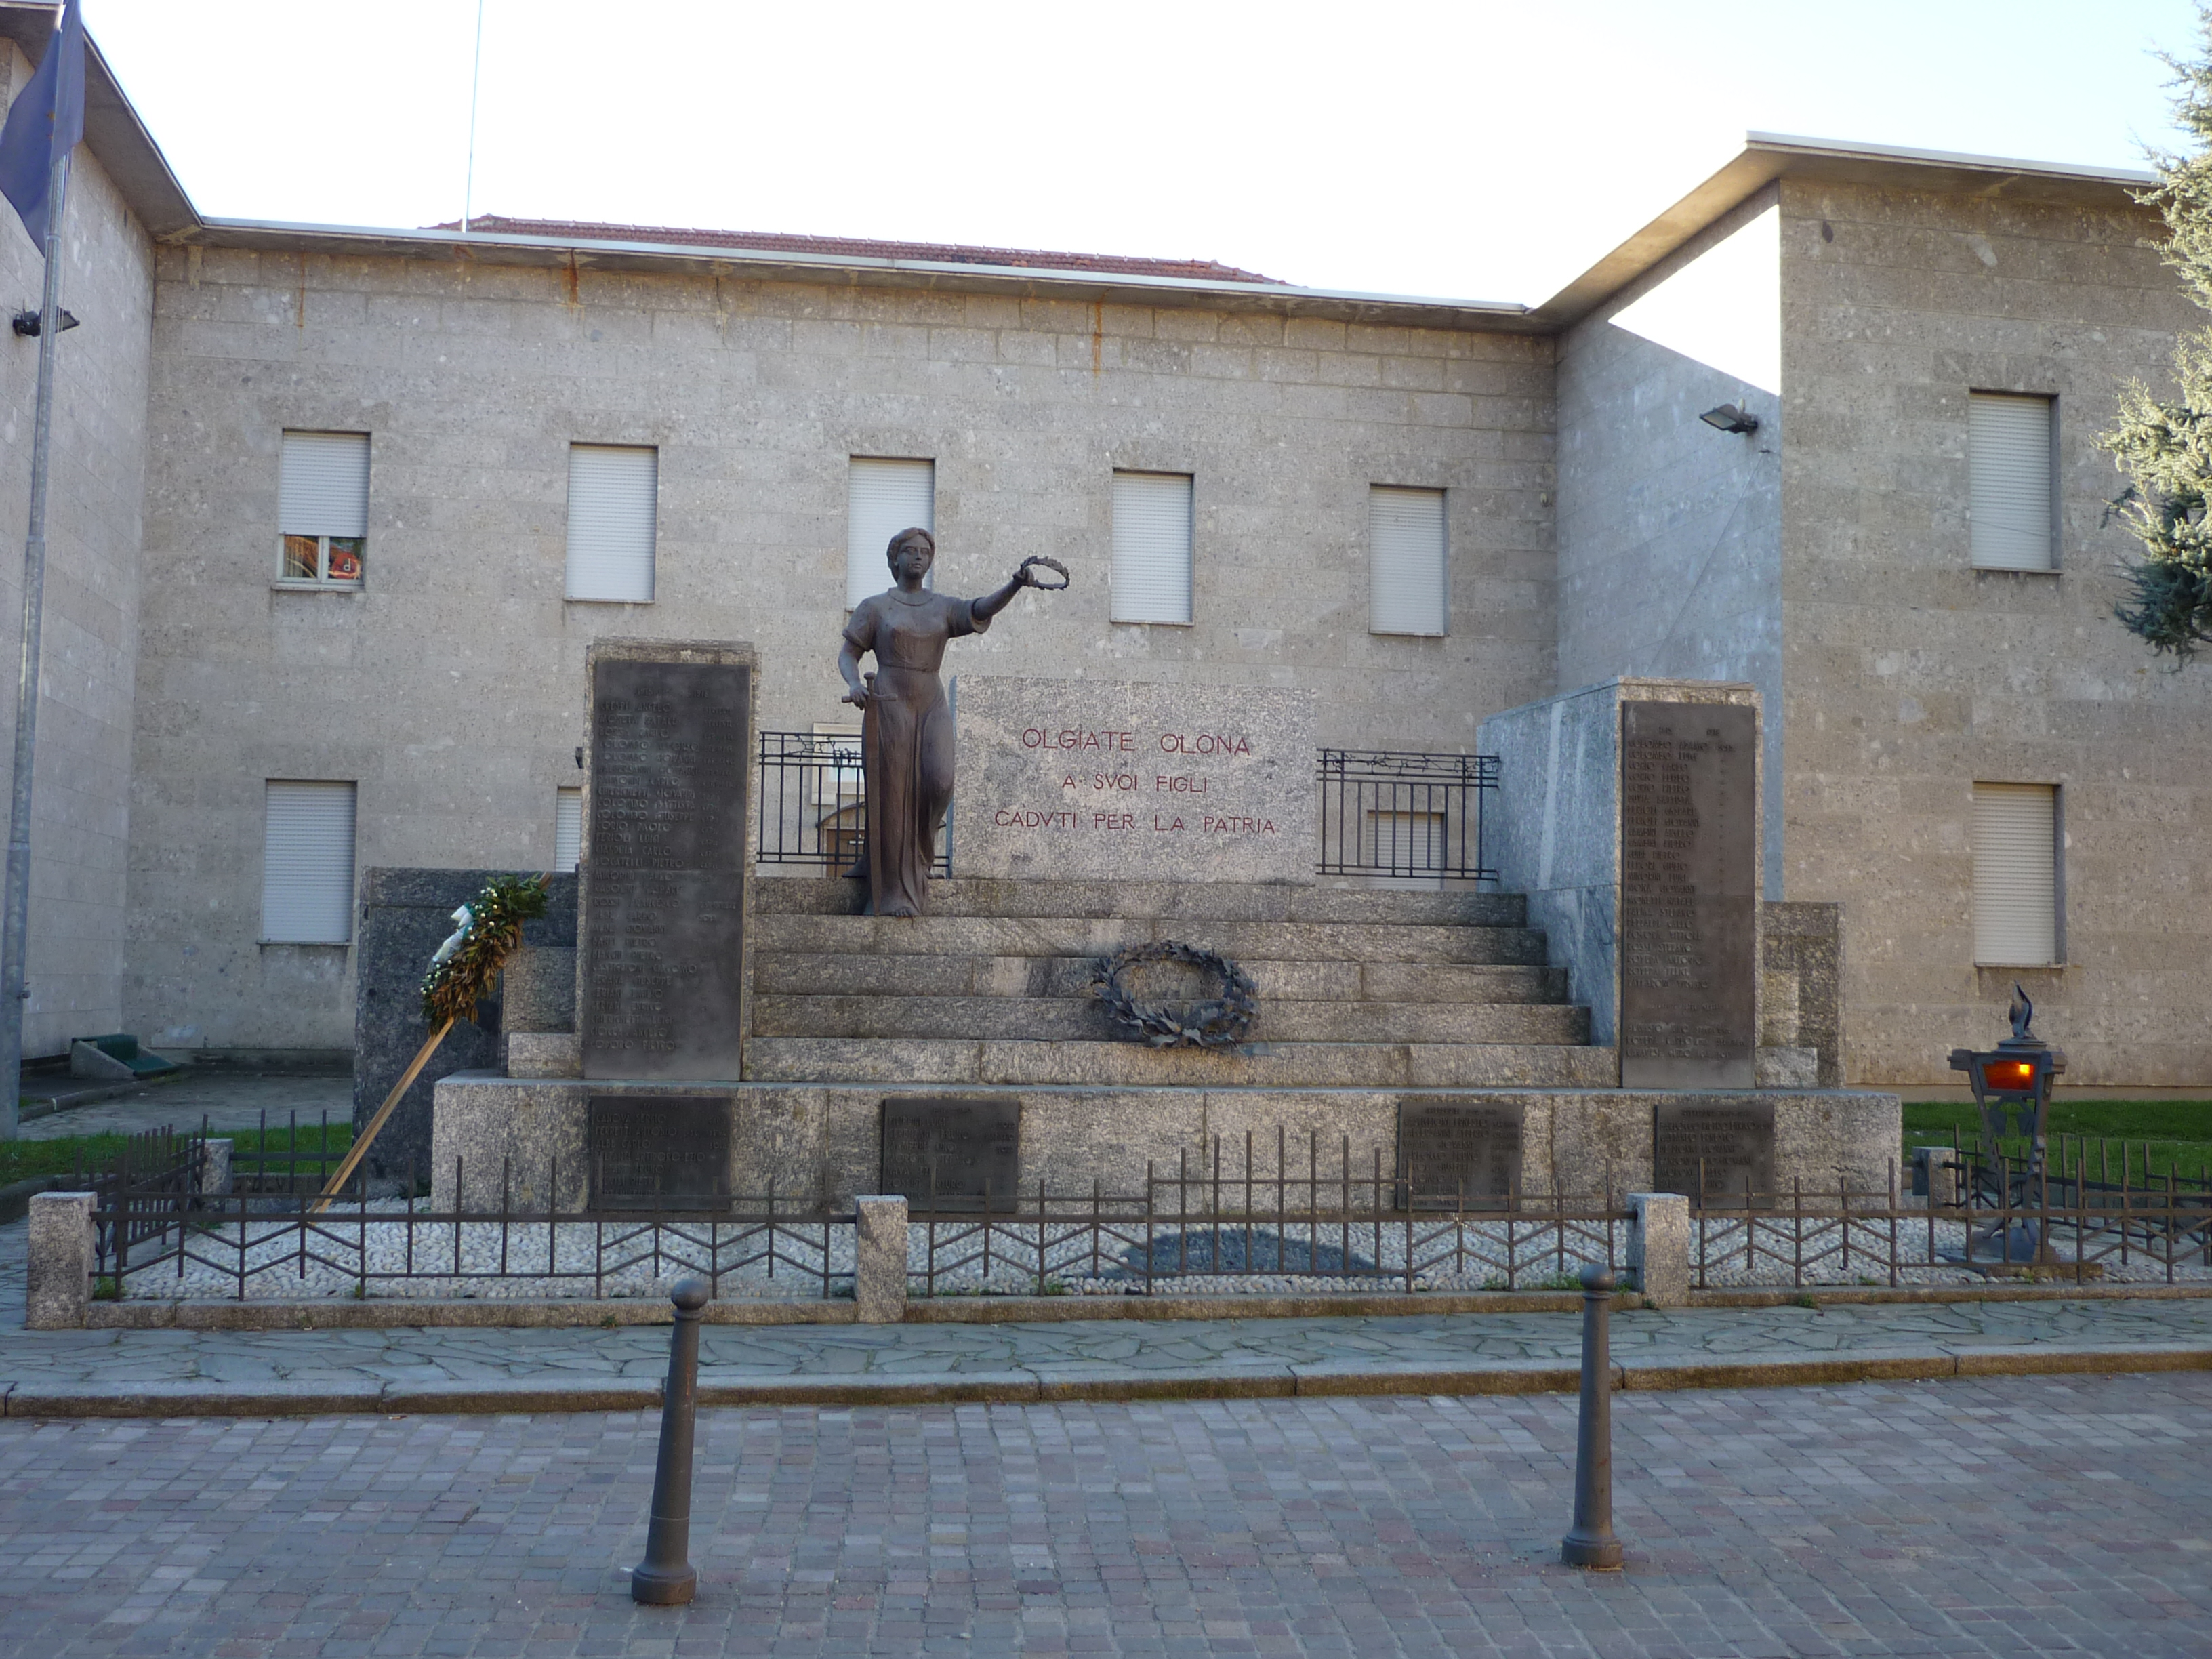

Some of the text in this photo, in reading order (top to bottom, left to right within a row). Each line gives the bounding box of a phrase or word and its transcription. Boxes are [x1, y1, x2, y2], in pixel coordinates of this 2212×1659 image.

[1023, 728, 1251, 756] OLGIATE OLONA
[1061, 774, 1208, 794] A SVOI FIGLI
[994, 810, 1275, 834] CADVTI PER LA PATRIA
